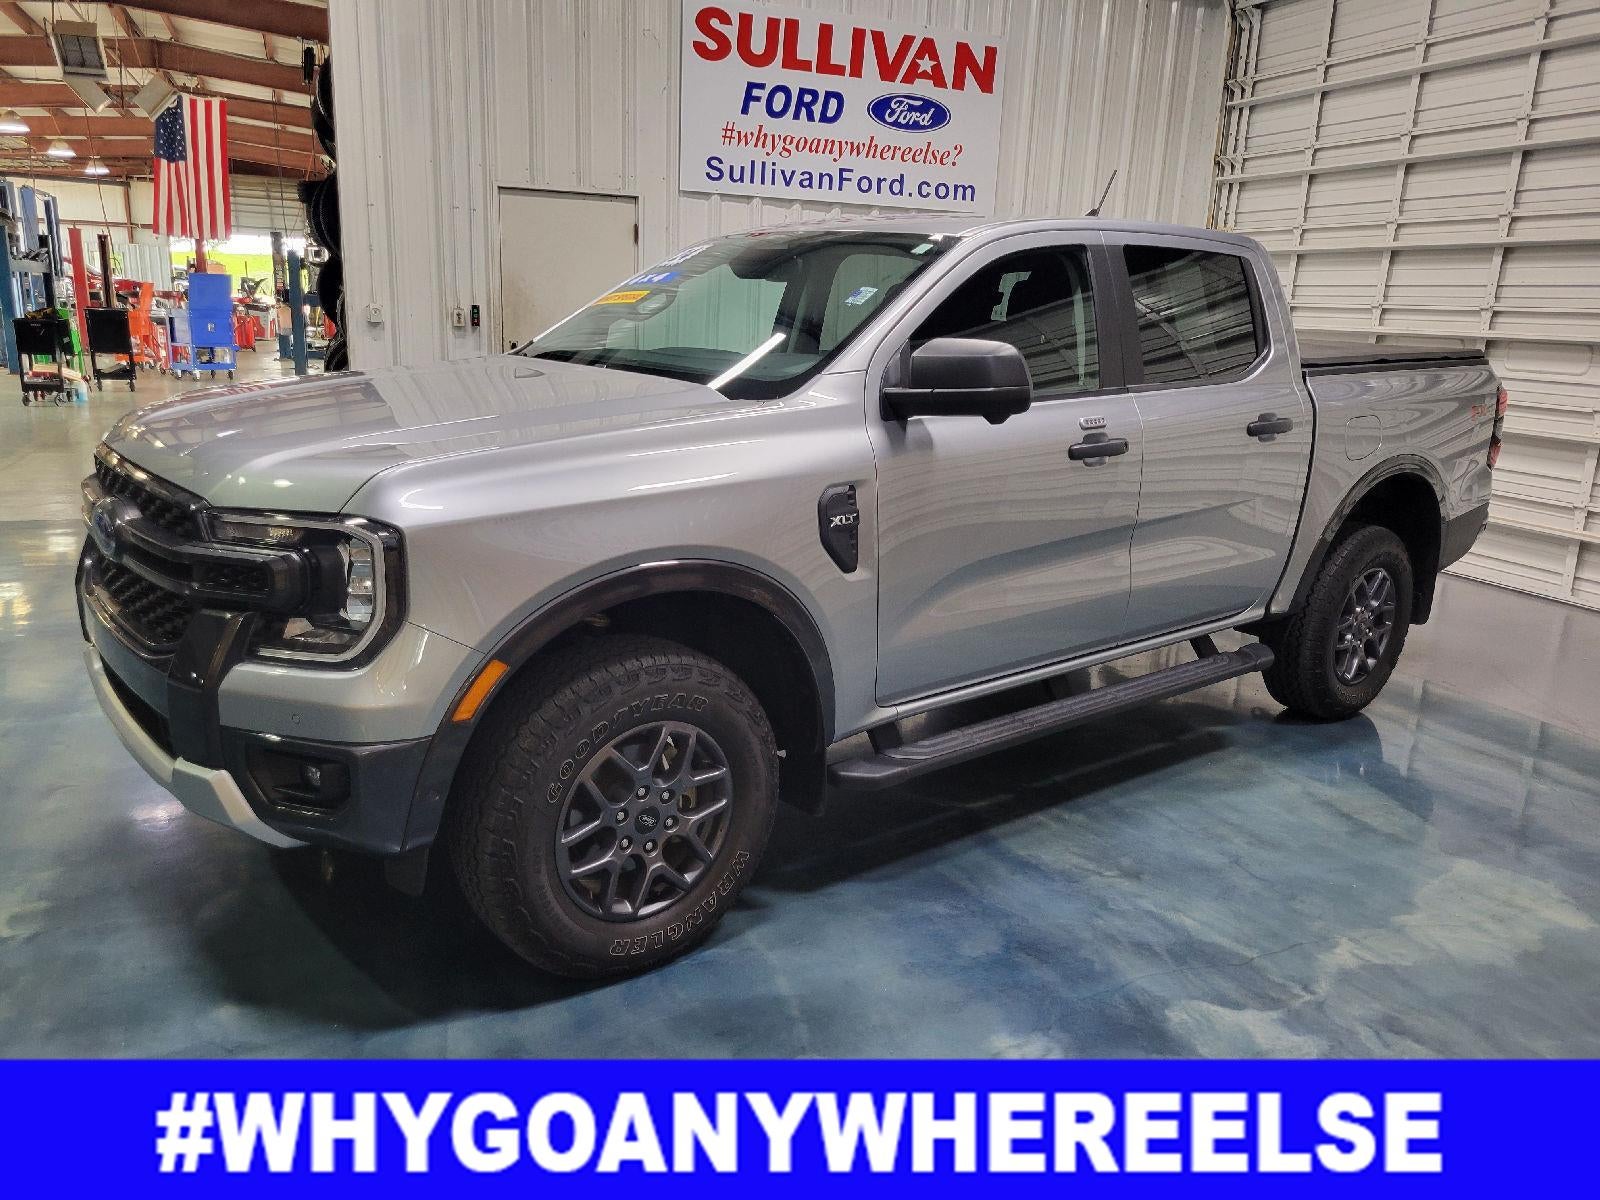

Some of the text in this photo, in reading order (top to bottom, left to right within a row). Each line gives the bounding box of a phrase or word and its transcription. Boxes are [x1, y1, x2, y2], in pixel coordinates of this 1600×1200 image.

[692, 6, 998, 94] SULLIVAN
[741, 81, 845, 124] FORD
[884, 97, 935, 126] Ford
[721, 120, 963, 167] #whygoanywhereelse?
[705, 156, 976, 202] SullivanFord.com
[829, 512, 857, 528] XLT
[547, 693, 709, 803] GOODYEAR
[609, 850, 750, 956] WRANGLER
